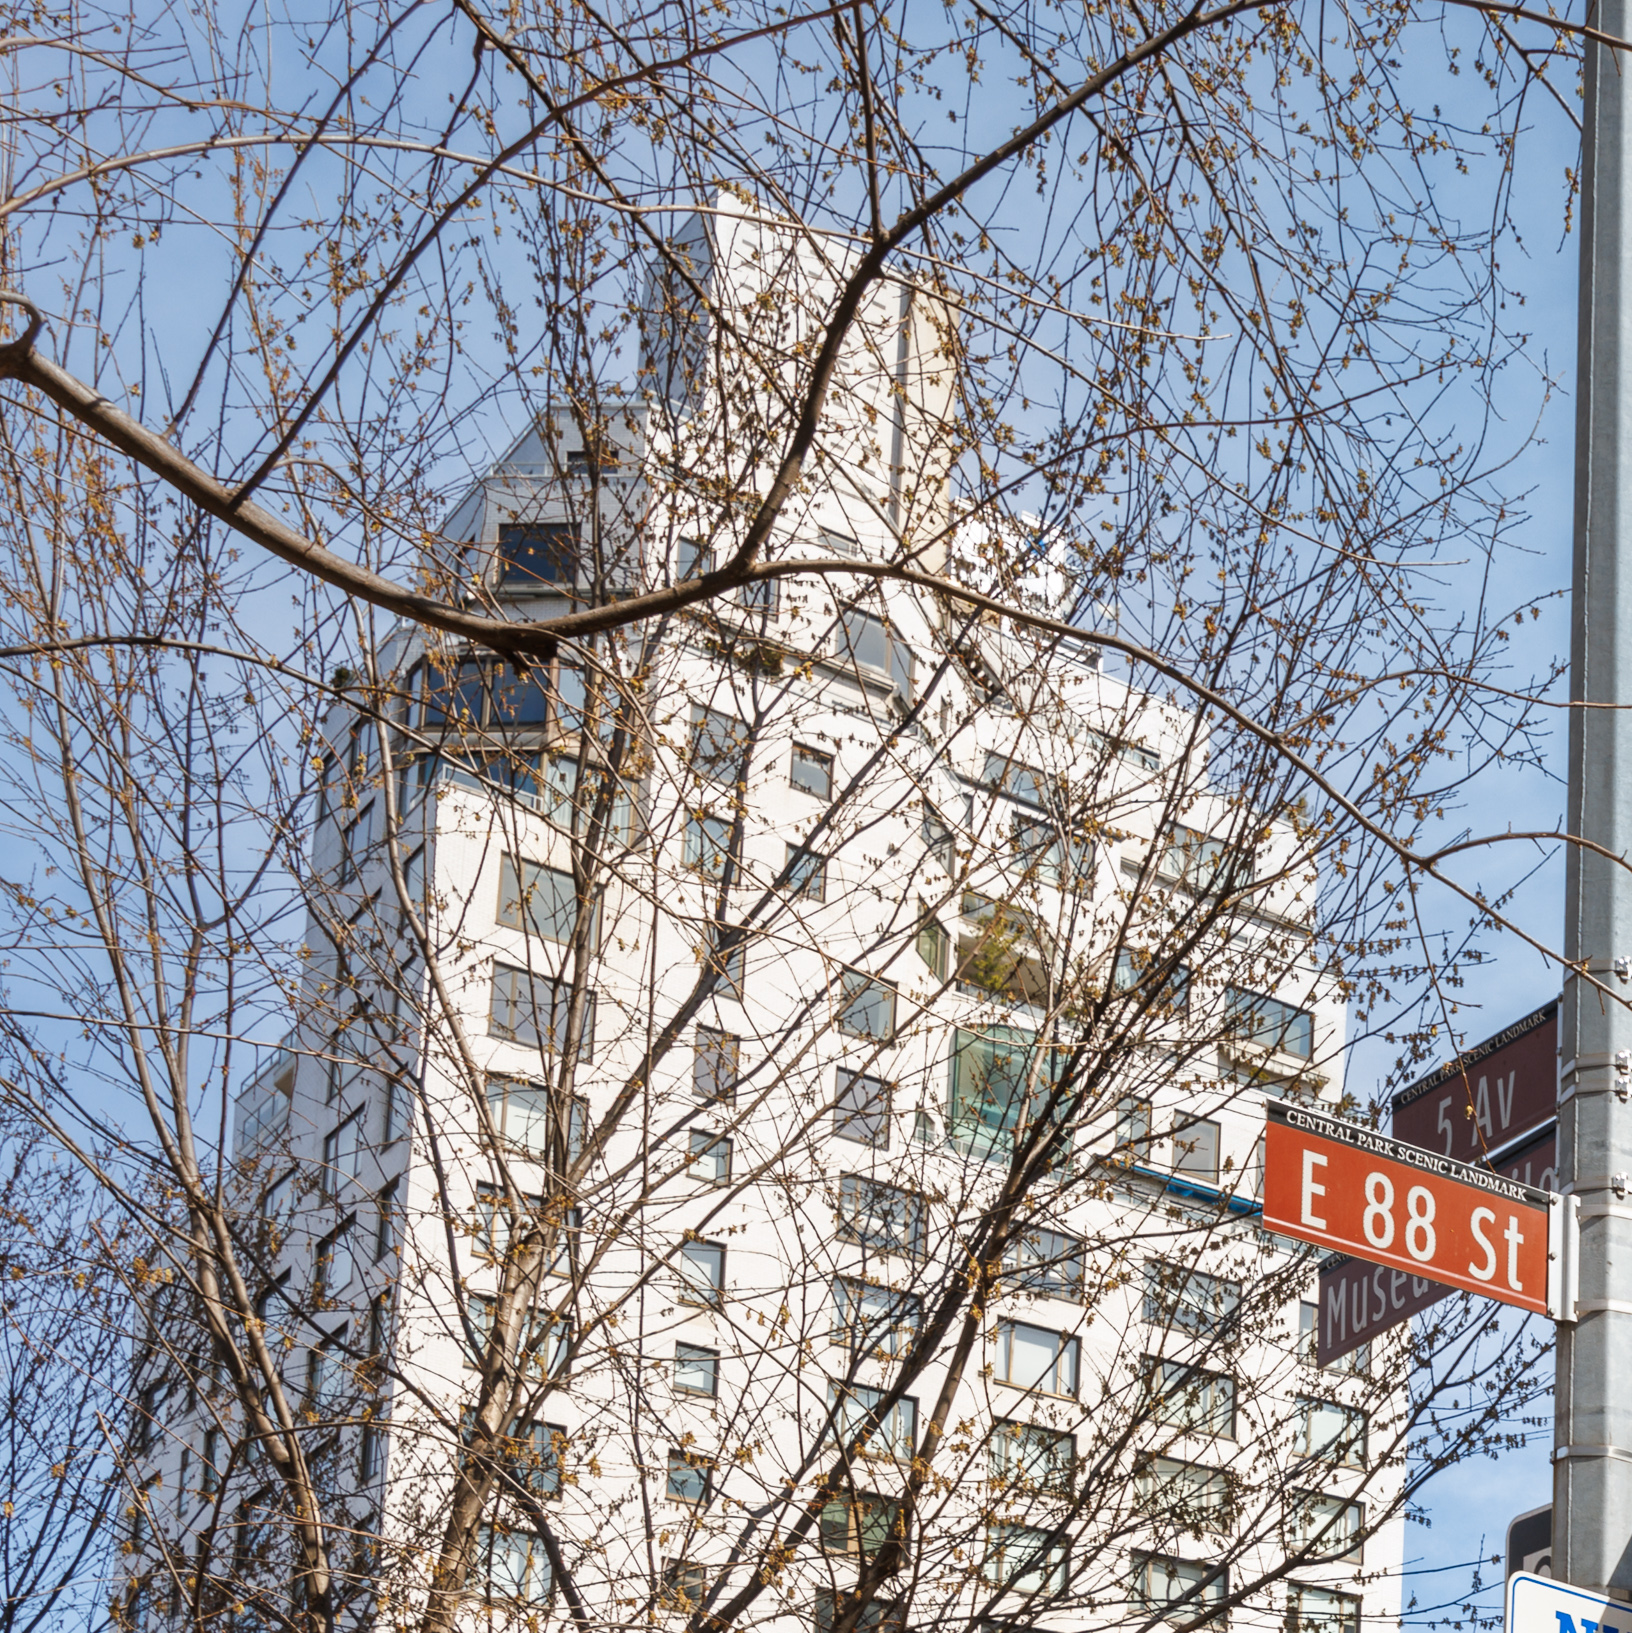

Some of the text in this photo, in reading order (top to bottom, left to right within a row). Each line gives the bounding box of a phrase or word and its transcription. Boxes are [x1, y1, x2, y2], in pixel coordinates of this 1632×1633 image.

[1401, 1010, 1547, 1105] CENTRAL PARK SCENIC LANDMARK
[1286, 1110, 1354, 1147] CENTRAL
[1357, 1129, 1395, 1158] PARK
[1397, 1143, 1448, 1177] SCENIC
[1450, 1159, 1528, 1201] LANDMARK
[1437, 1070, 1515, 1157] 5 Av
[1301, 1149, 1524, 1292] E 88 St
